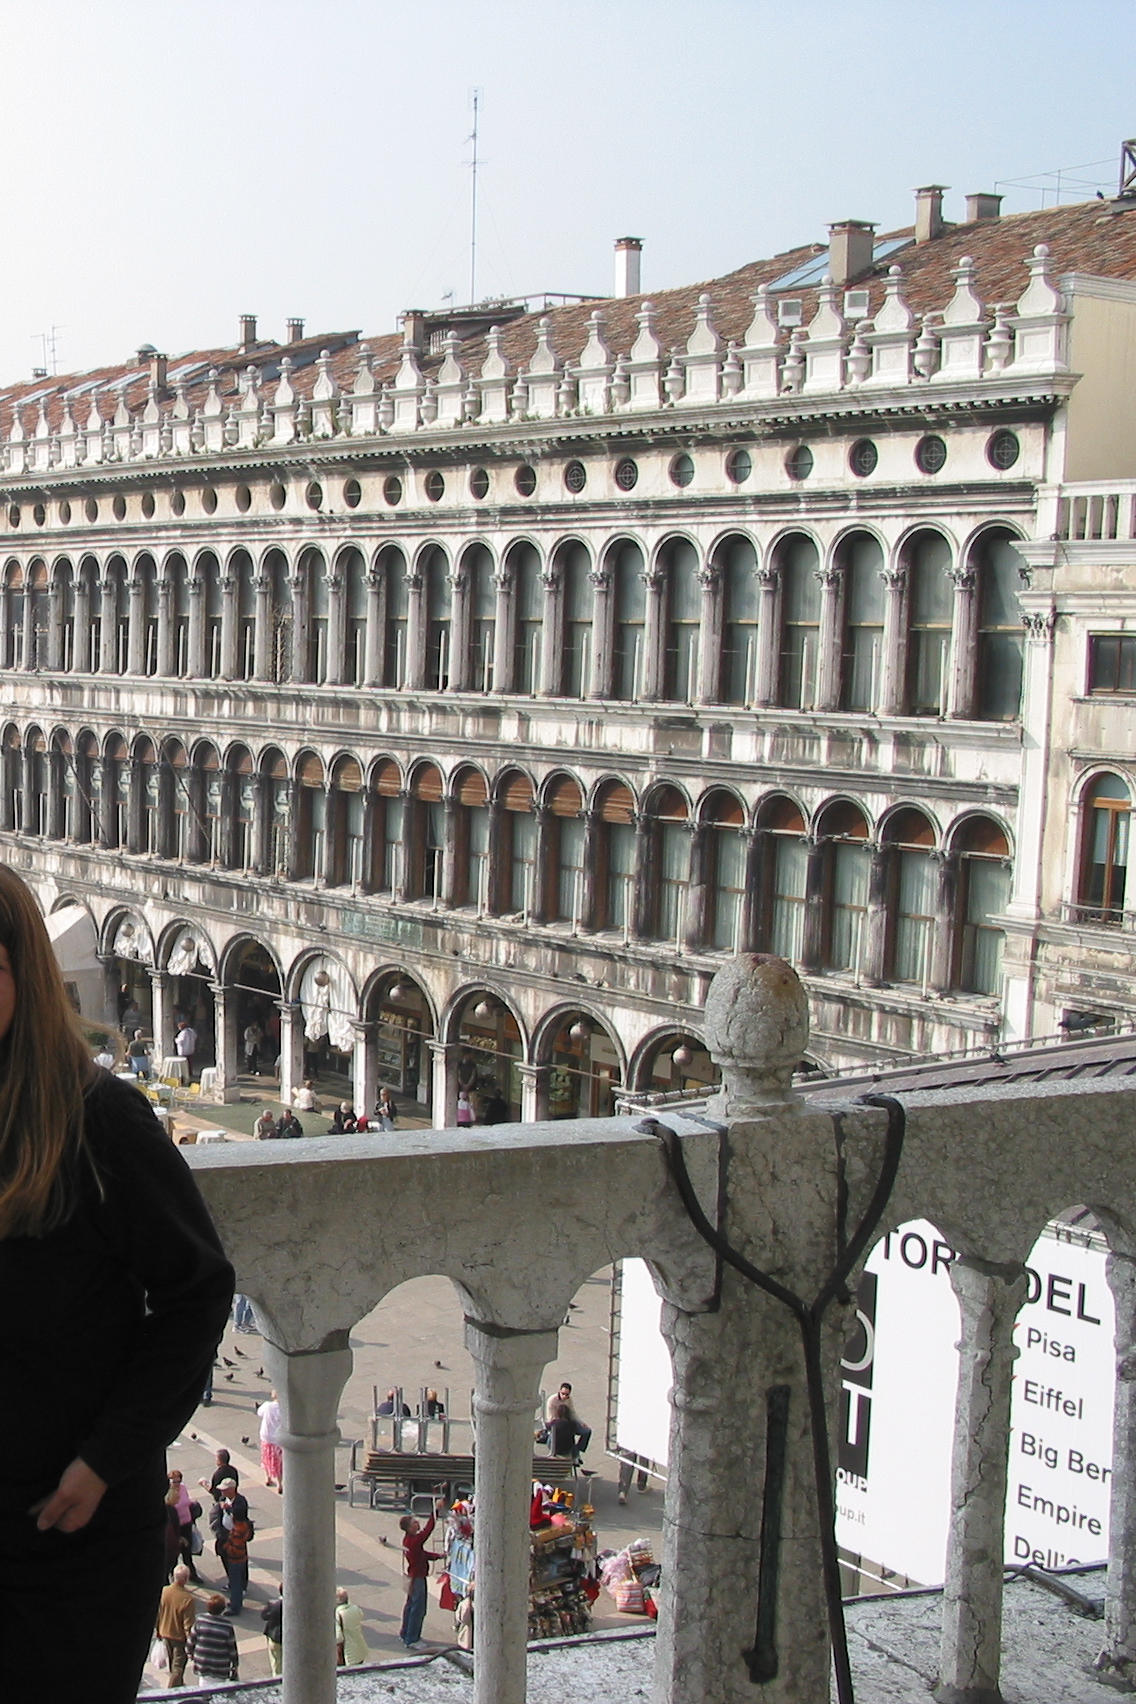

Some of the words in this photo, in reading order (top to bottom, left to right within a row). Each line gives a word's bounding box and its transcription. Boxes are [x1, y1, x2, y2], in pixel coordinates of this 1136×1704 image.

[1027, 1327, 1076, 1363] Pisa
[1024, 1379, 1083, 1420] Eiffel
[1021, 1431, 1059, 1469] Big
[1017, 1483, 1102, 1536] Empire
